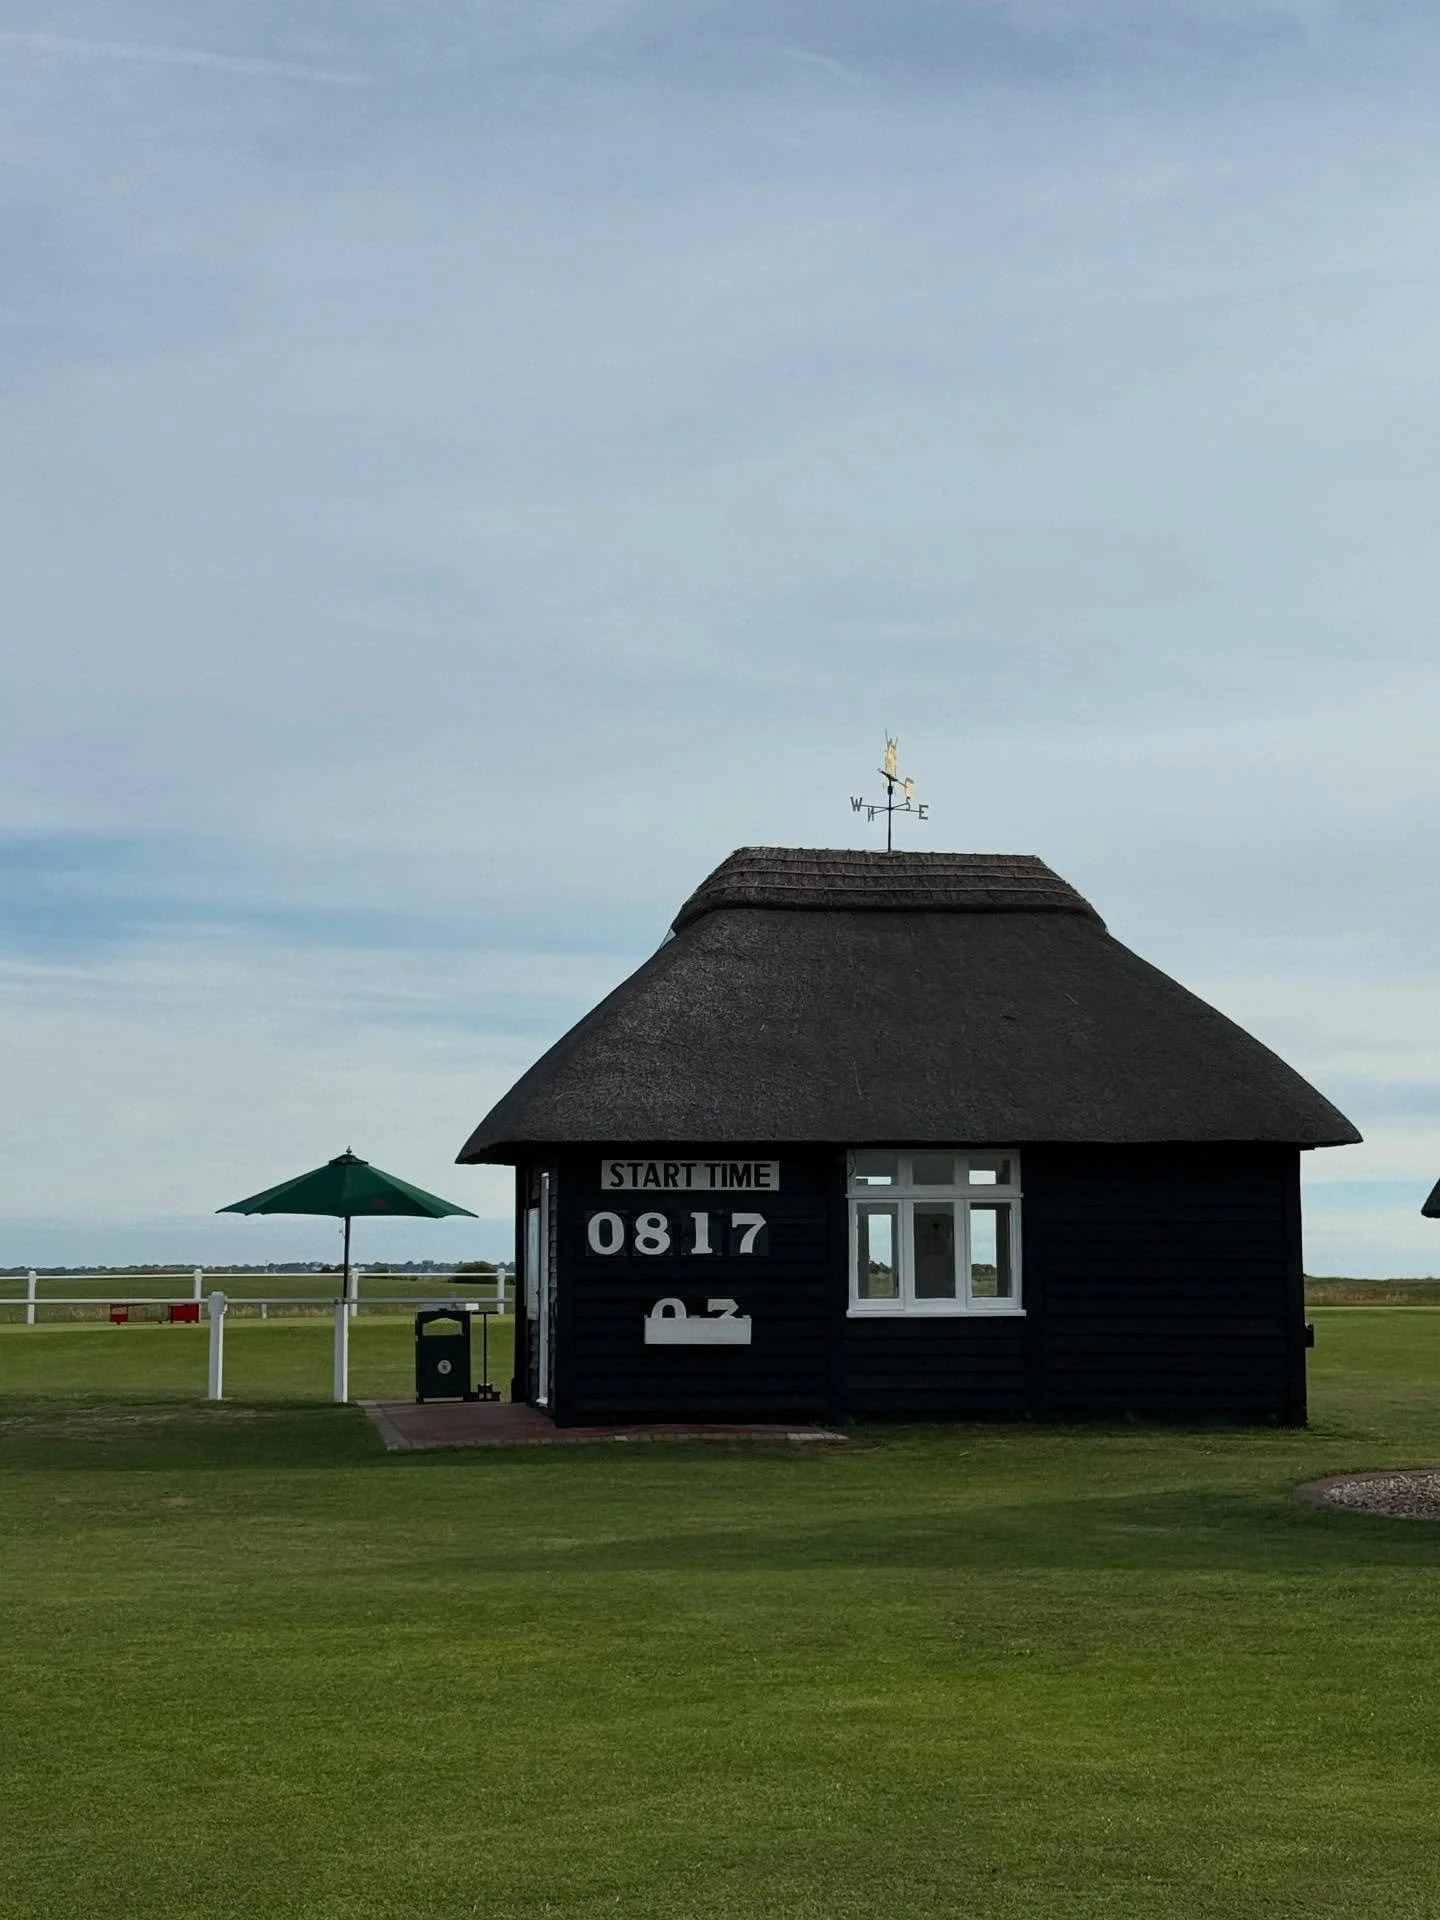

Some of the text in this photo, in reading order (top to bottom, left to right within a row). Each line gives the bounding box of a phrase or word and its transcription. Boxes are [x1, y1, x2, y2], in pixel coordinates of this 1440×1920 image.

[850, 796, 863, 812] W
[918, 804, 929, 820] E
[609, 1162, 771, 1188] START TIME
